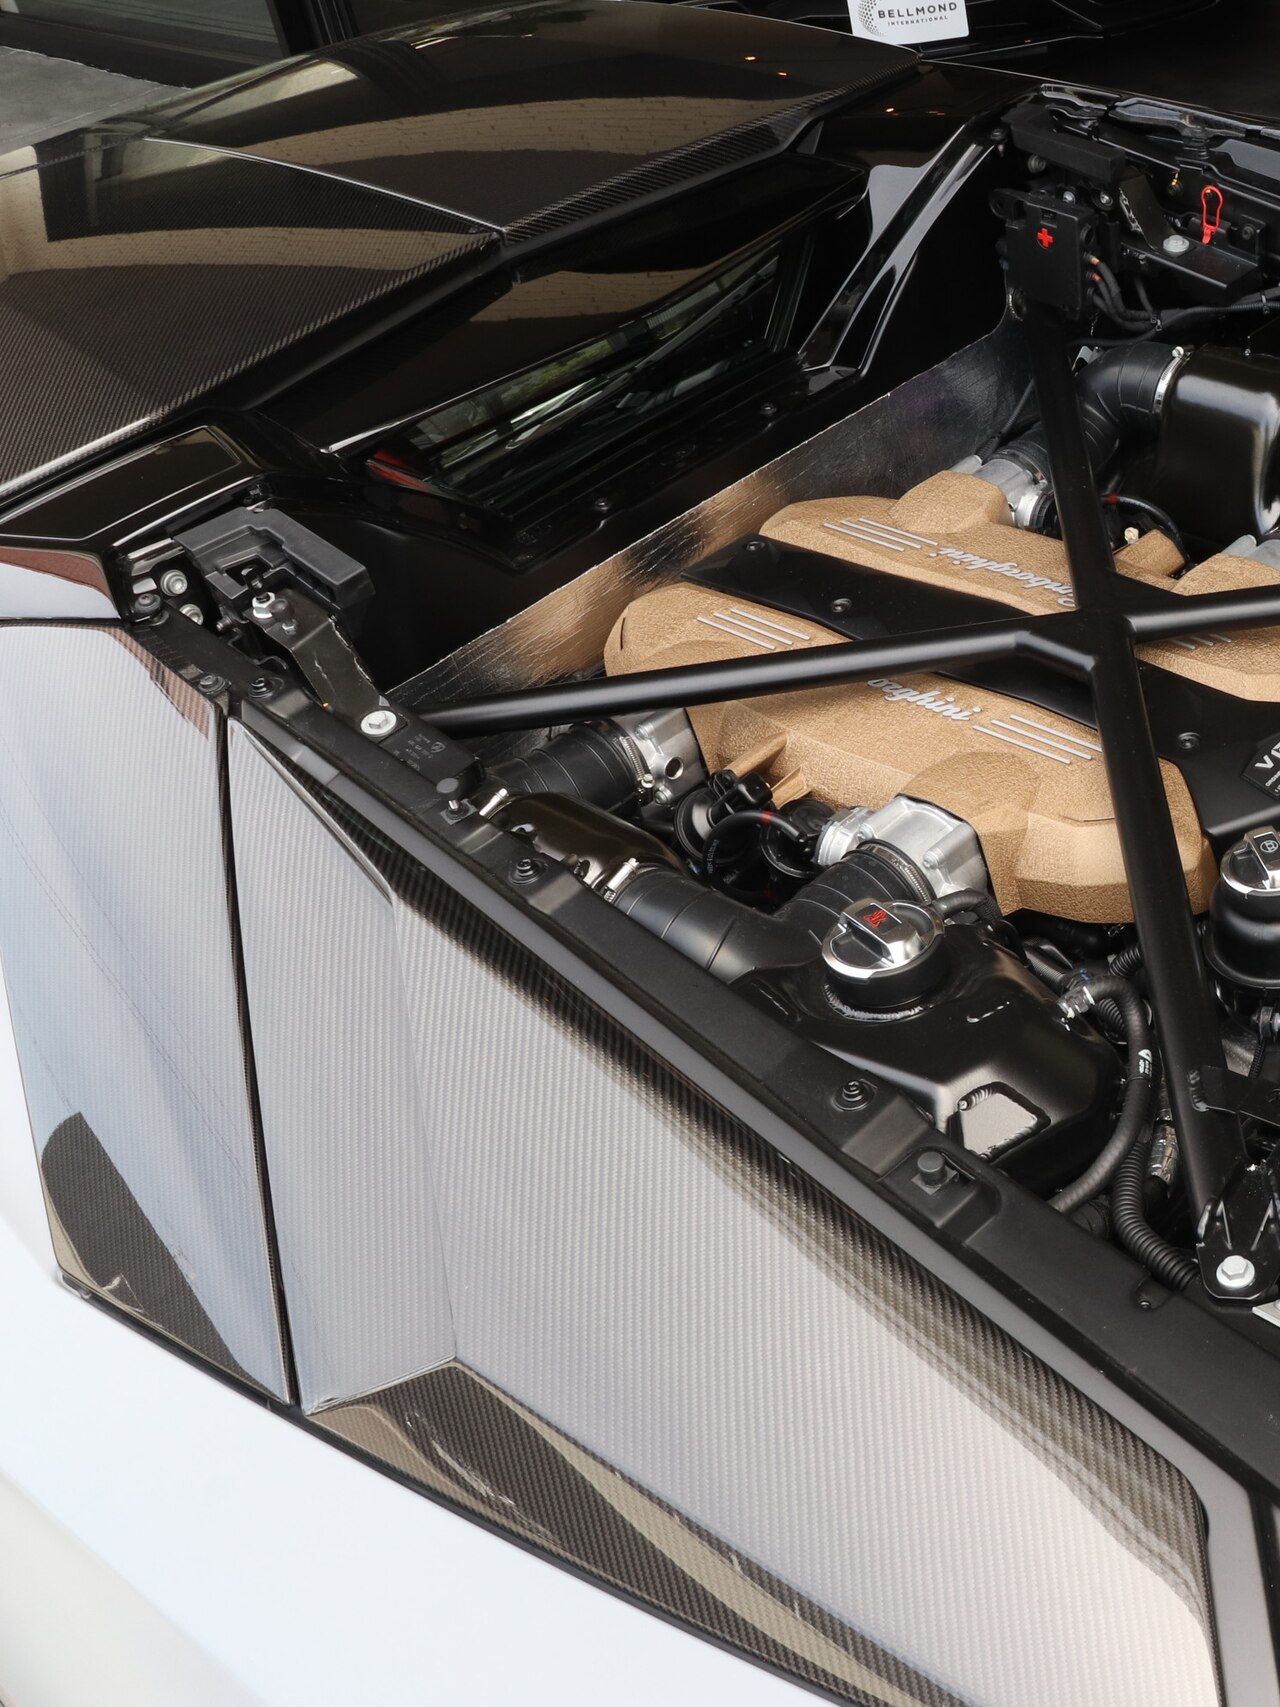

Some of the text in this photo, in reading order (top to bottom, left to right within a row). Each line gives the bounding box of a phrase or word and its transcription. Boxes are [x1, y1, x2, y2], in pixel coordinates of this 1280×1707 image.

[878, 2, 957, 19] BELLMOND
[887, 15, 948, 26] INTERNATIONAL
[928, 547, 1075, 607] mborghini
[866, 679, 982, 721] orghini
